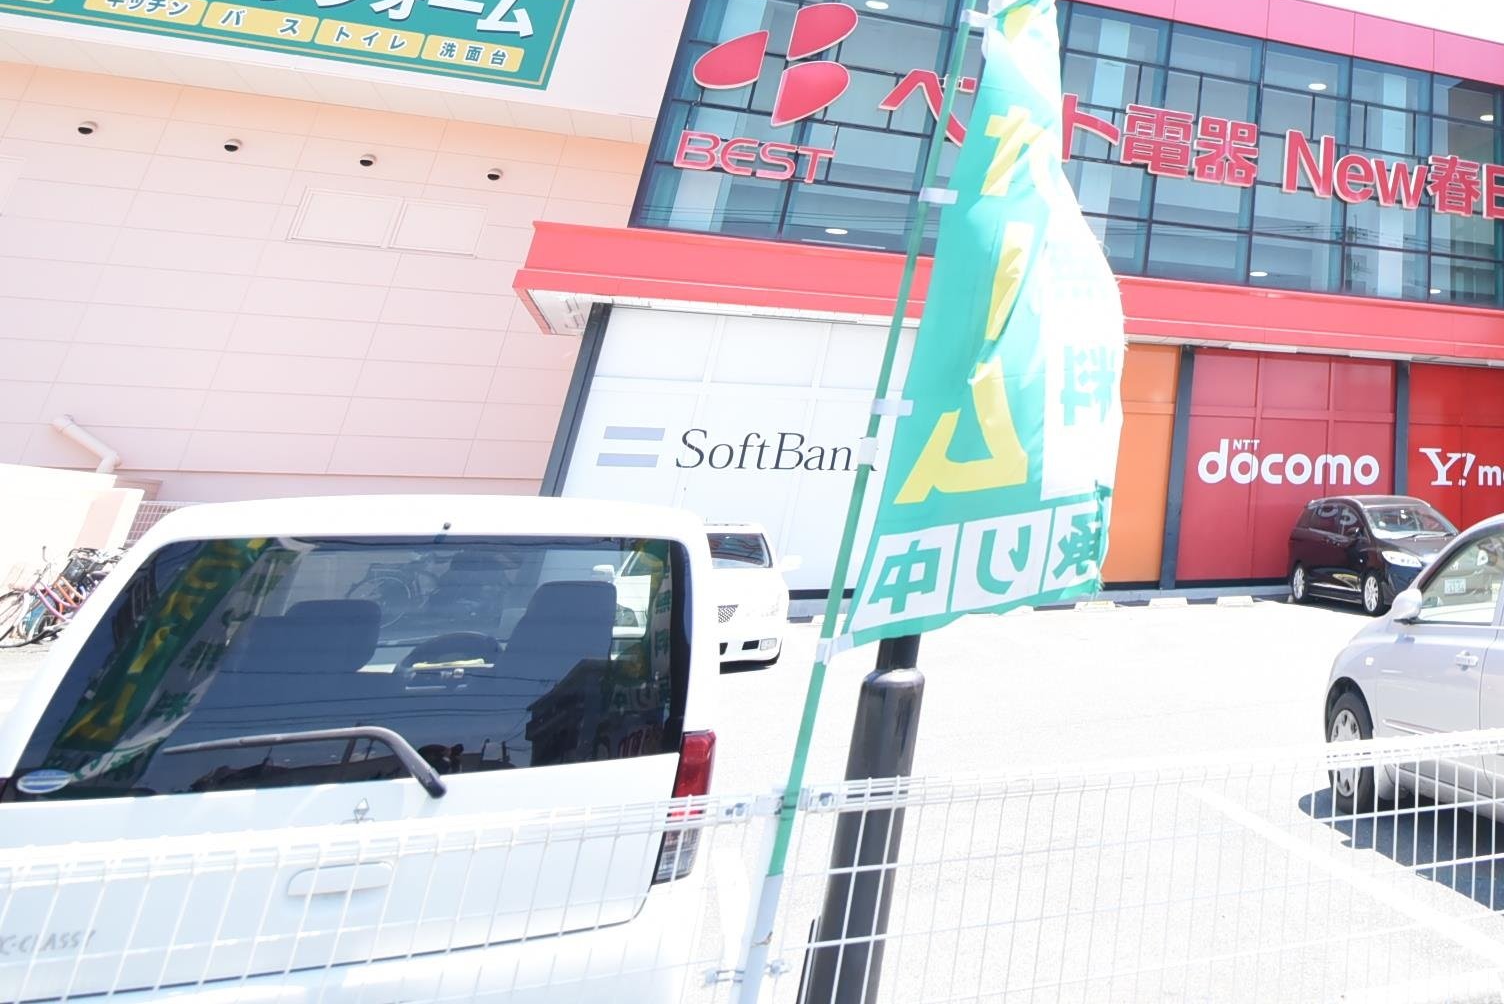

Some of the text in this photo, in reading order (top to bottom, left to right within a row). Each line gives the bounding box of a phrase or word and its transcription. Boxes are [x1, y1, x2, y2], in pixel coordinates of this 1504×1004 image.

[220, 9, 299, 36] バス
[334, 25, 406, 51] トイレ
[438, 41, 508, 67] 洗面台
[878, 68, 1259, 187] ベト電器
[673, 130, 835, 184] BEST
[1198, 439, 1380, 486] docomo
[1233, 439, 1260, 450] NTT
